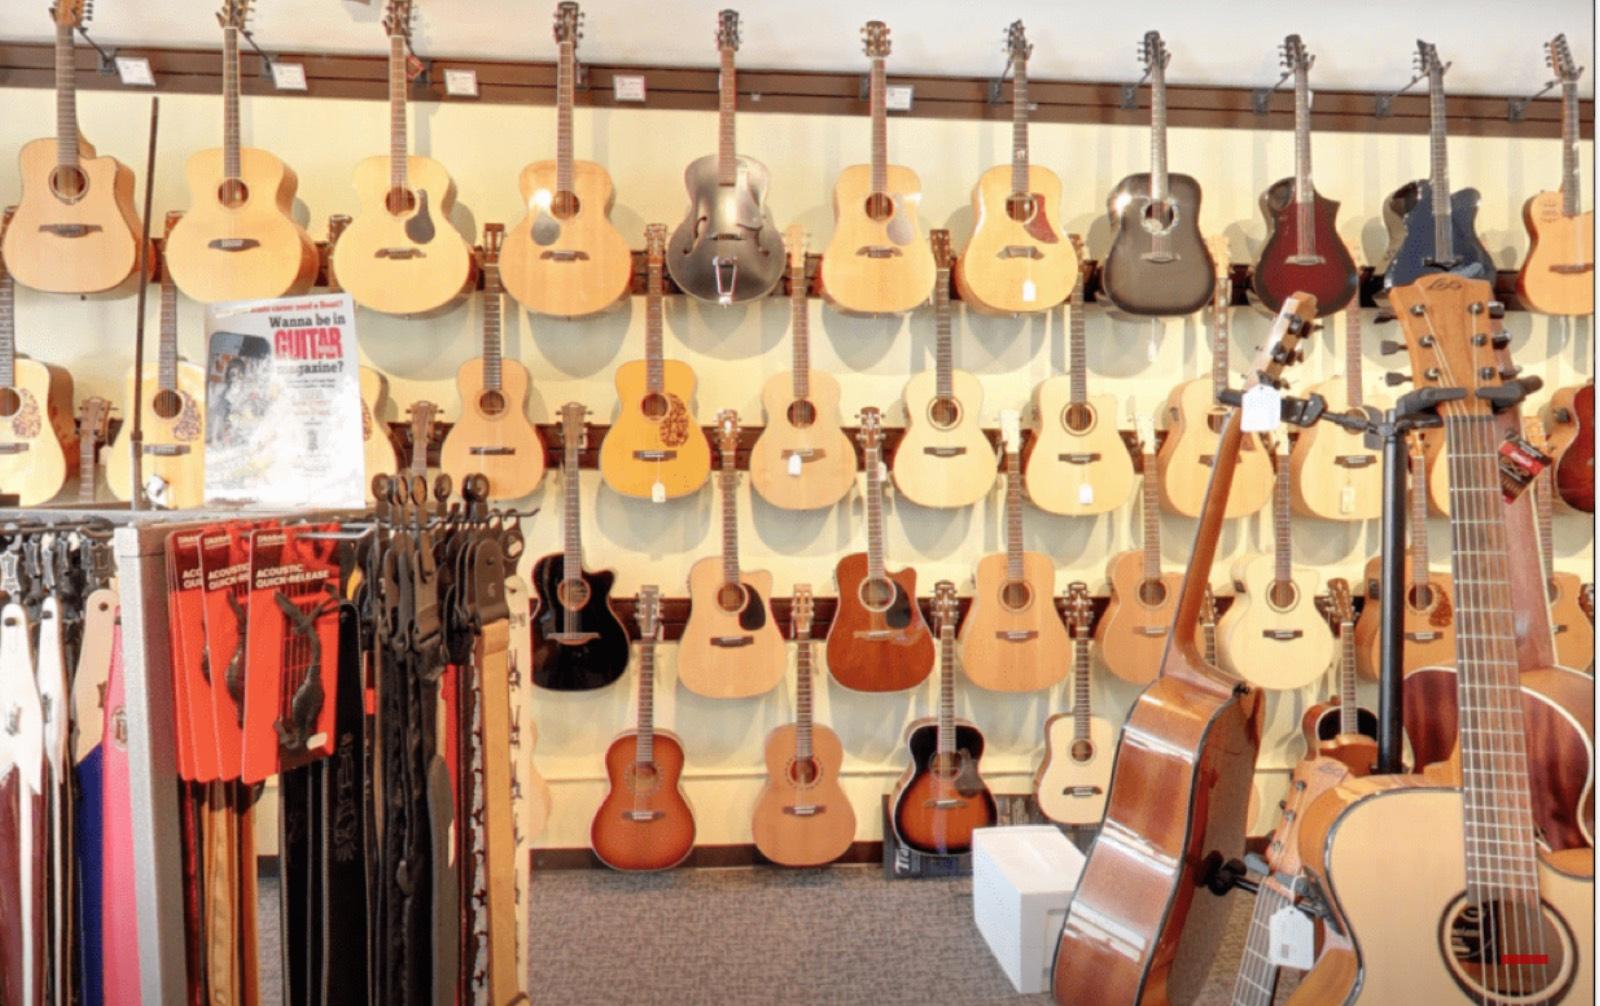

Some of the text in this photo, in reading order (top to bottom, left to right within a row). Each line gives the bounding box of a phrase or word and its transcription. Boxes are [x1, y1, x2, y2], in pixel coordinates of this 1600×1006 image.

[269, 312, 346, 328] Wanna be in
[274, 327, 342, 360] GUITAR
[255, 563, 304, 578] ACOUSTIC
[255, 569, 330, 588] QUICK-RELEASE
